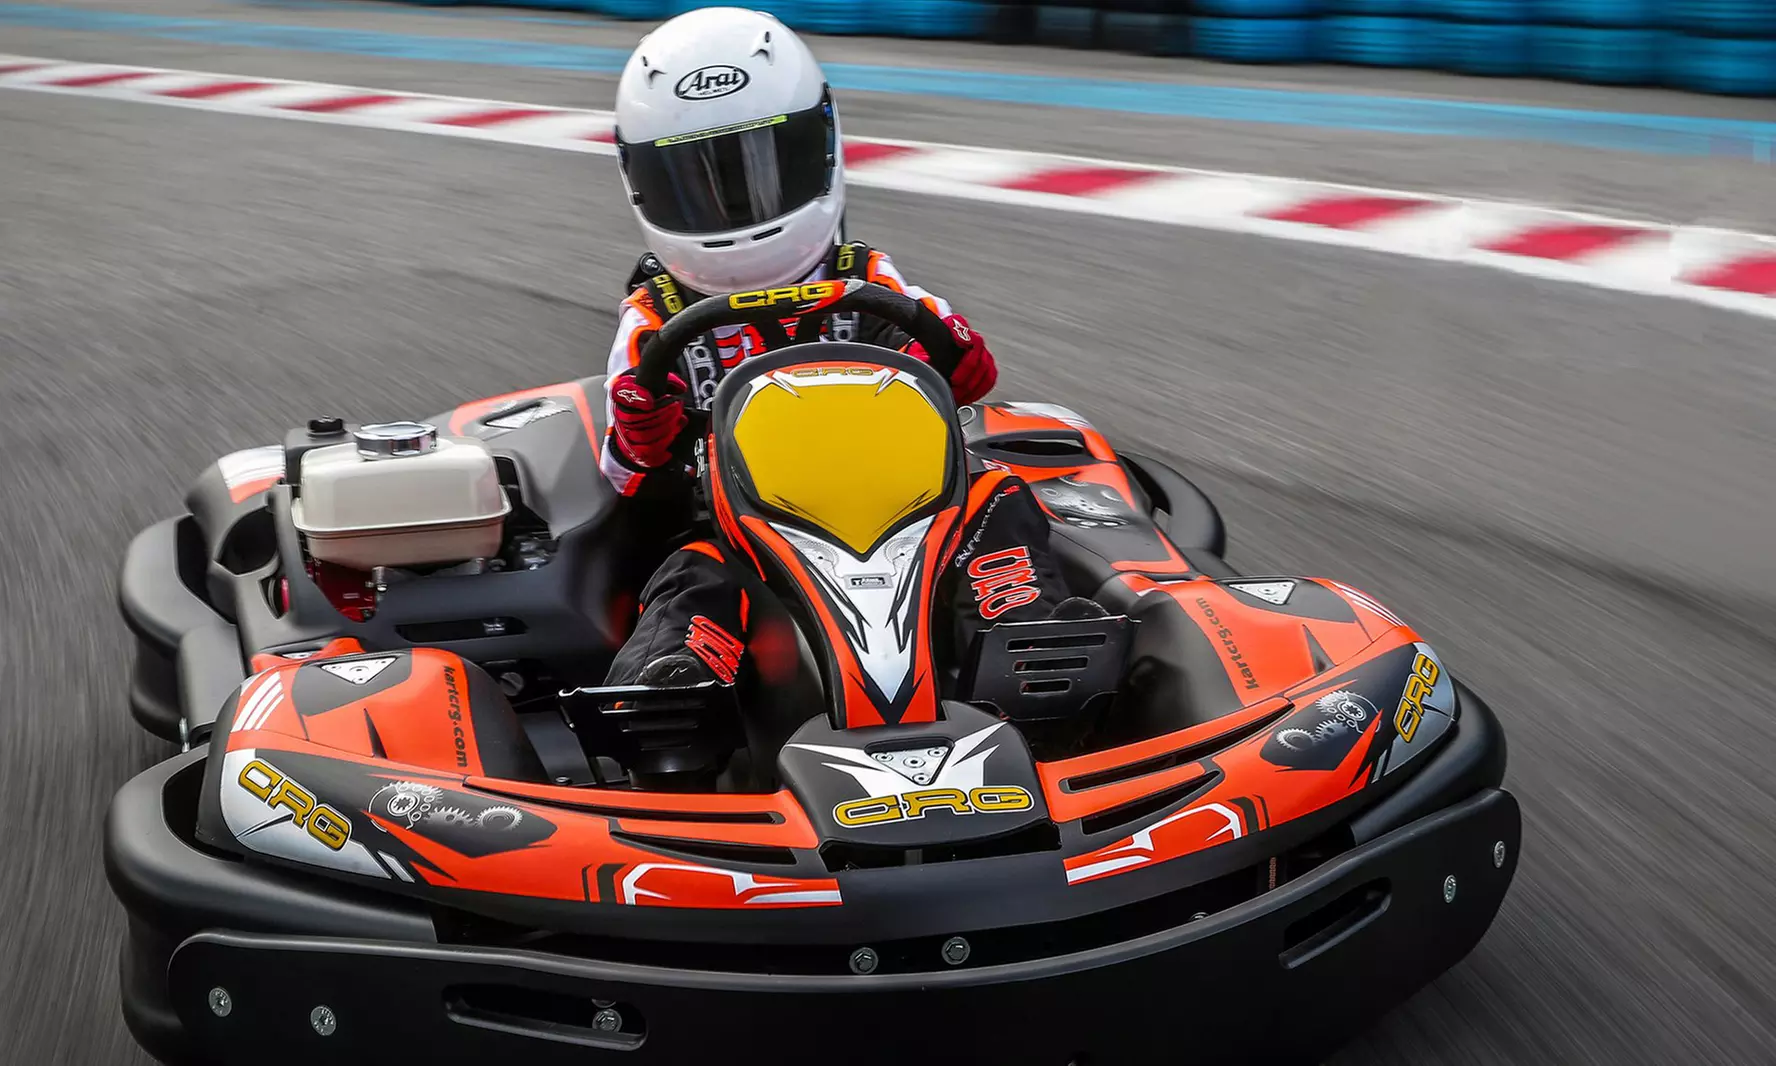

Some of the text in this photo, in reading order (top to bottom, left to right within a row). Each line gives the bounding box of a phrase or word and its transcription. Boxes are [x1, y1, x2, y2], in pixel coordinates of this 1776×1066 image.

[680, 68, 741, 95] Arai
[652, 274, 684, 314] CRG
[729, 282, 834, 310] CRG
[790, 366, 874, 378] CRG
[1196, 597, 1260, 690] kartcrg.com
[442, 664, 468, 769] kartcrg.com
[1393, 652, 1440, 743] CRG
[236, 757, 354, 852] CRG
[831, 784, 1035, 828] CRG
